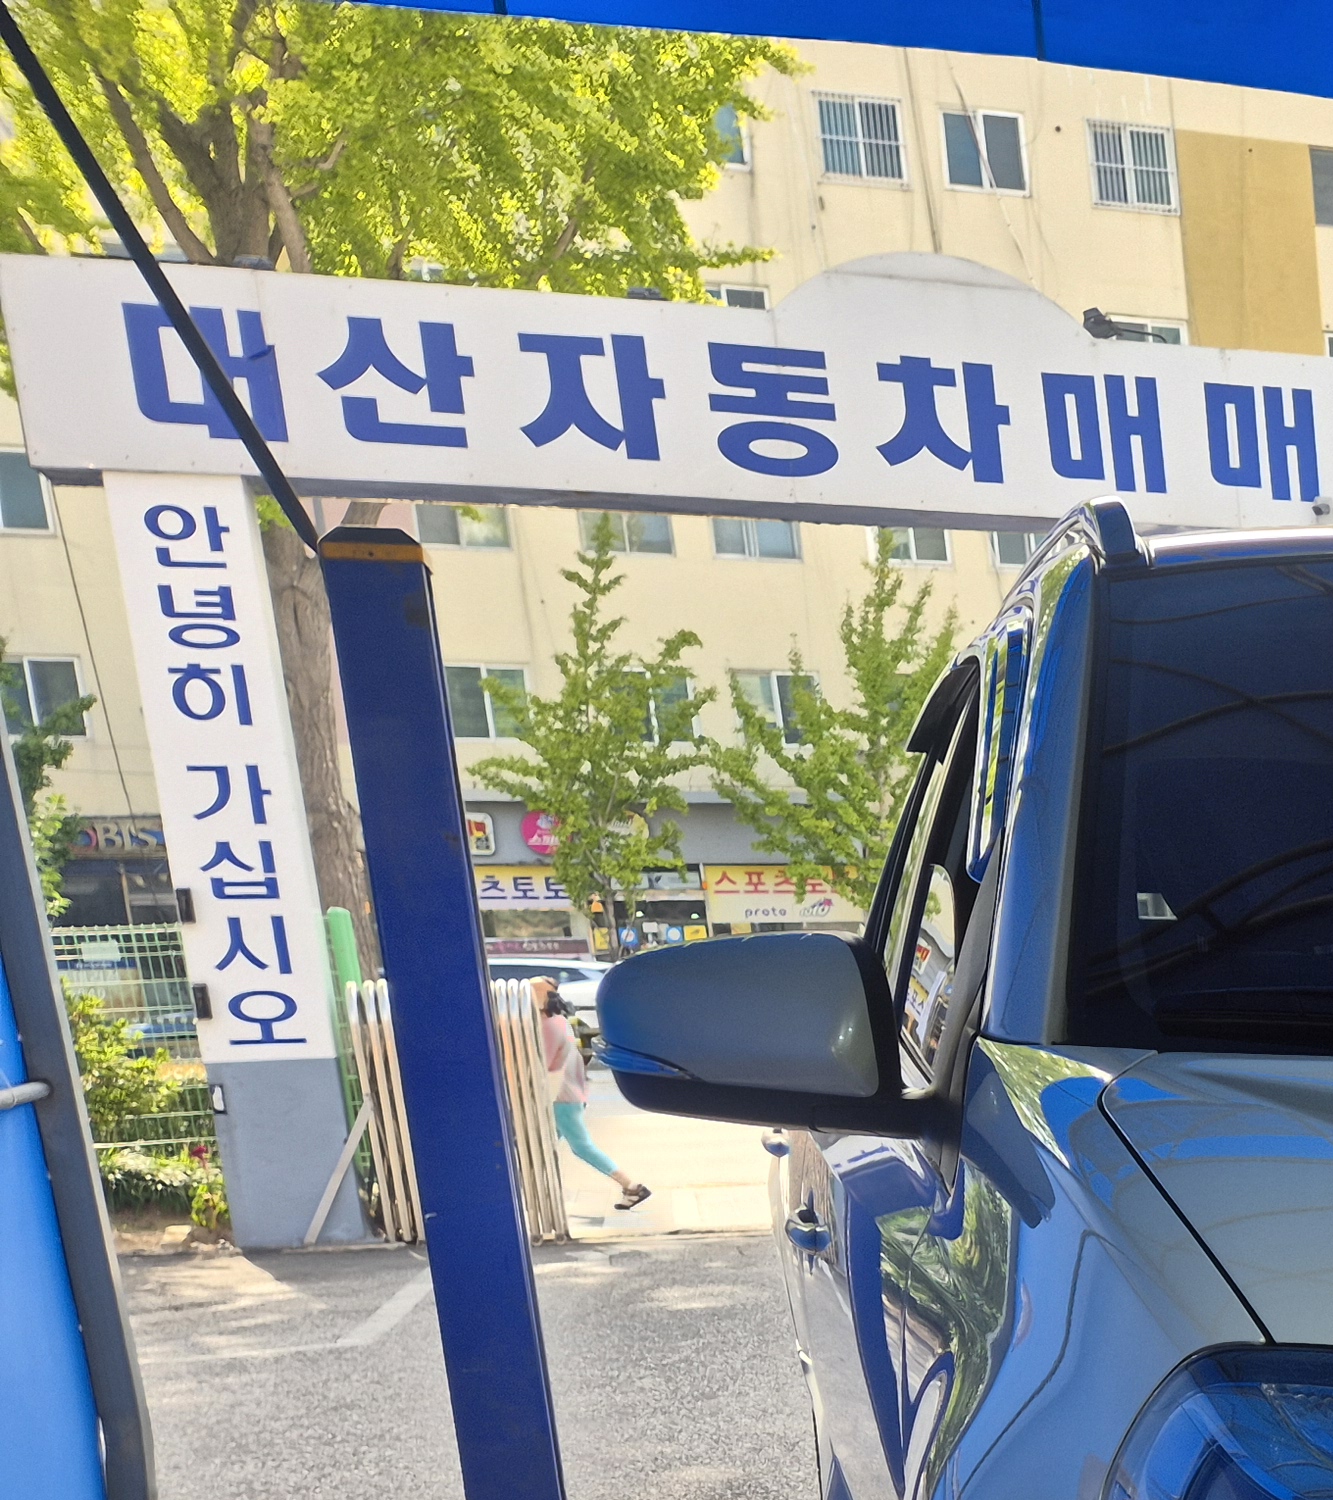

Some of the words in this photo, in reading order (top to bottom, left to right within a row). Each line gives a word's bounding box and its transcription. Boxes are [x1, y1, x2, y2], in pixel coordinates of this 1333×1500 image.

[143, 503, 253, 727] 안녕히
[76, 820, 158, 850] OBIS
[479, 875, 571, 900] 츠토토
[713, 870, 852, 894] 스포츠토
[186, 763, 308, 1046] 가십시오
[744, 906, 787, 918] proto
